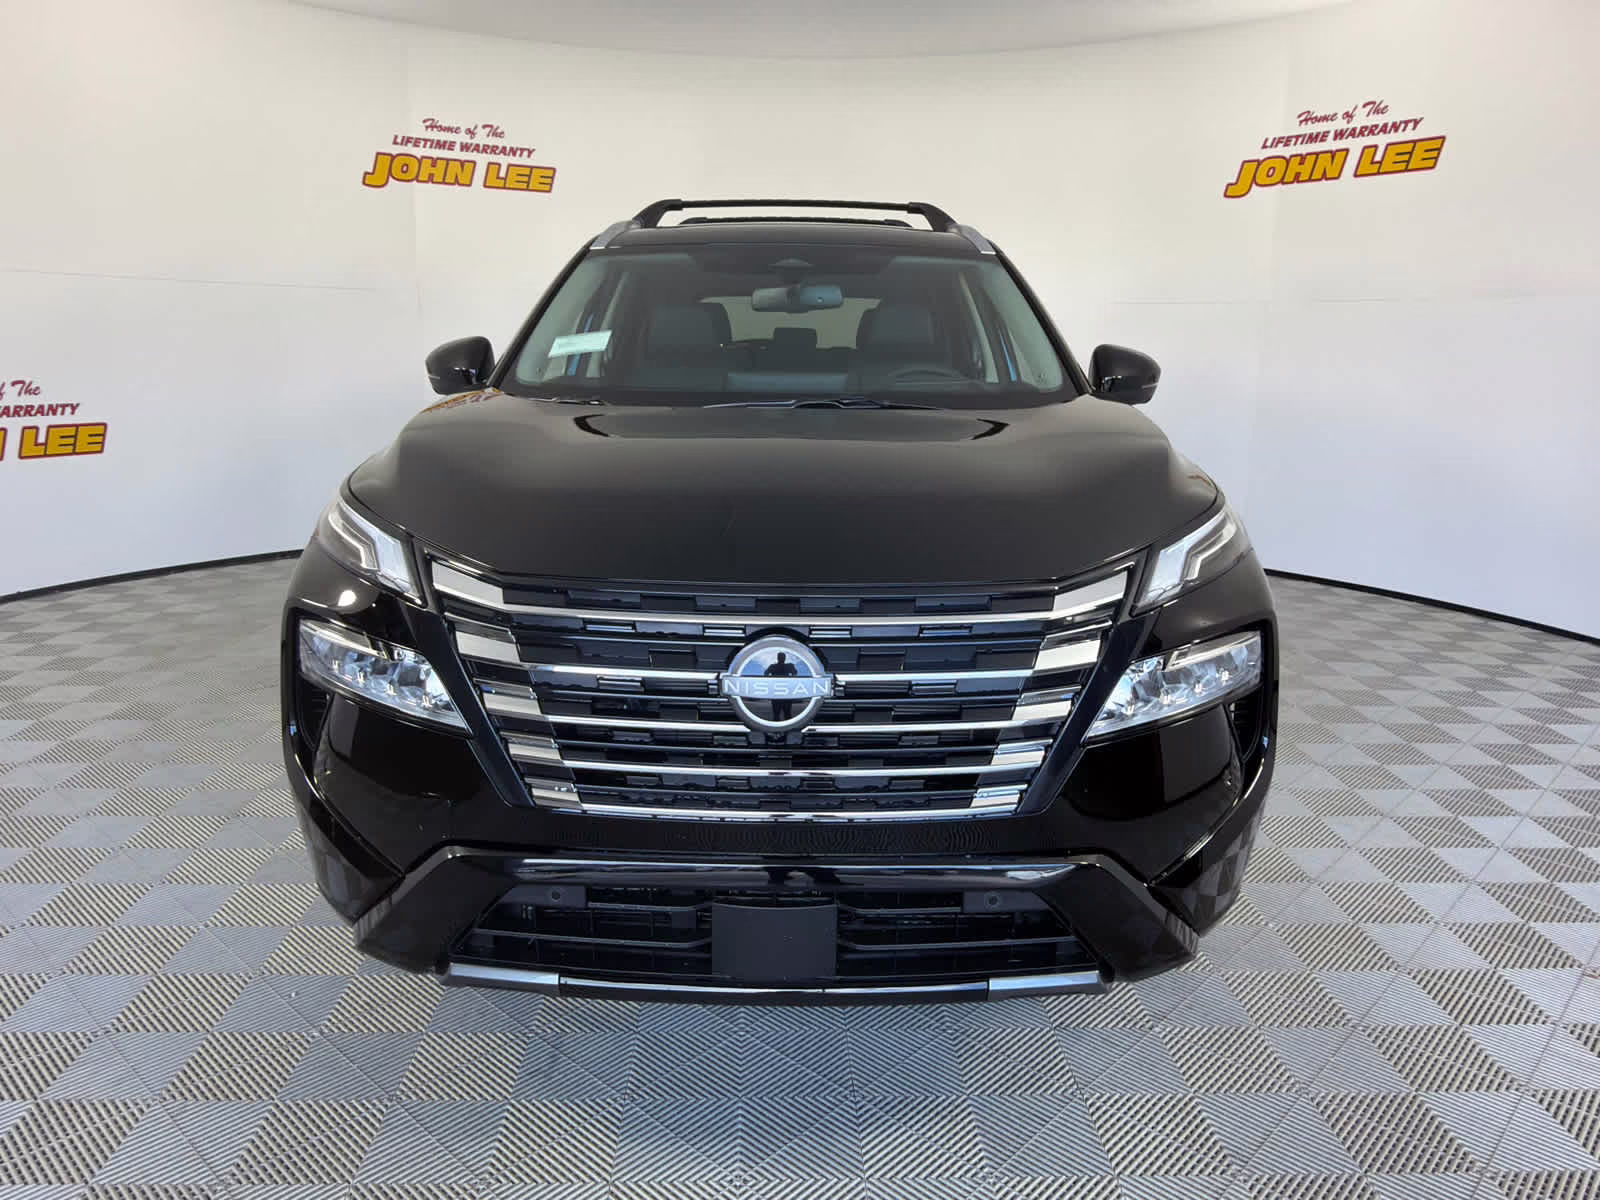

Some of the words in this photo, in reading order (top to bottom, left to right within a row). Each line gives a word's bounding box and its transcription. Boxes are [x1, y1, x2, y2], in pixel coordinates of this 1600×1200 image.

[1297, 110, 1338, 127] Home
[1341, 105, 1358, 123] of
[1362, 100, 1389, 117] The
[422, 118, 461, 136] Home
[464, 124, 478, 140] of
[481, 124, 505, 139] The
[1260, 129, 1330, 150] LIFETIME
[1332, 117, 1424, 141] WARRANTY
[391, 134, 457, 152] LIFETIME
[459, 141, 536, 159] WARRANTY
[362, 152, 476, 188] JOHN
[483, 161, 556, 193] LEE
[1223, 148, 1350, 199] JOHN
[1353, 135, 1446, 178] LEE
[10, 379, 41, 397] The
[0, 402, 80, 418] ARRANTY
[18, 422, 107, 460] LEE
[723, 678, 830, 697] NISSAN
